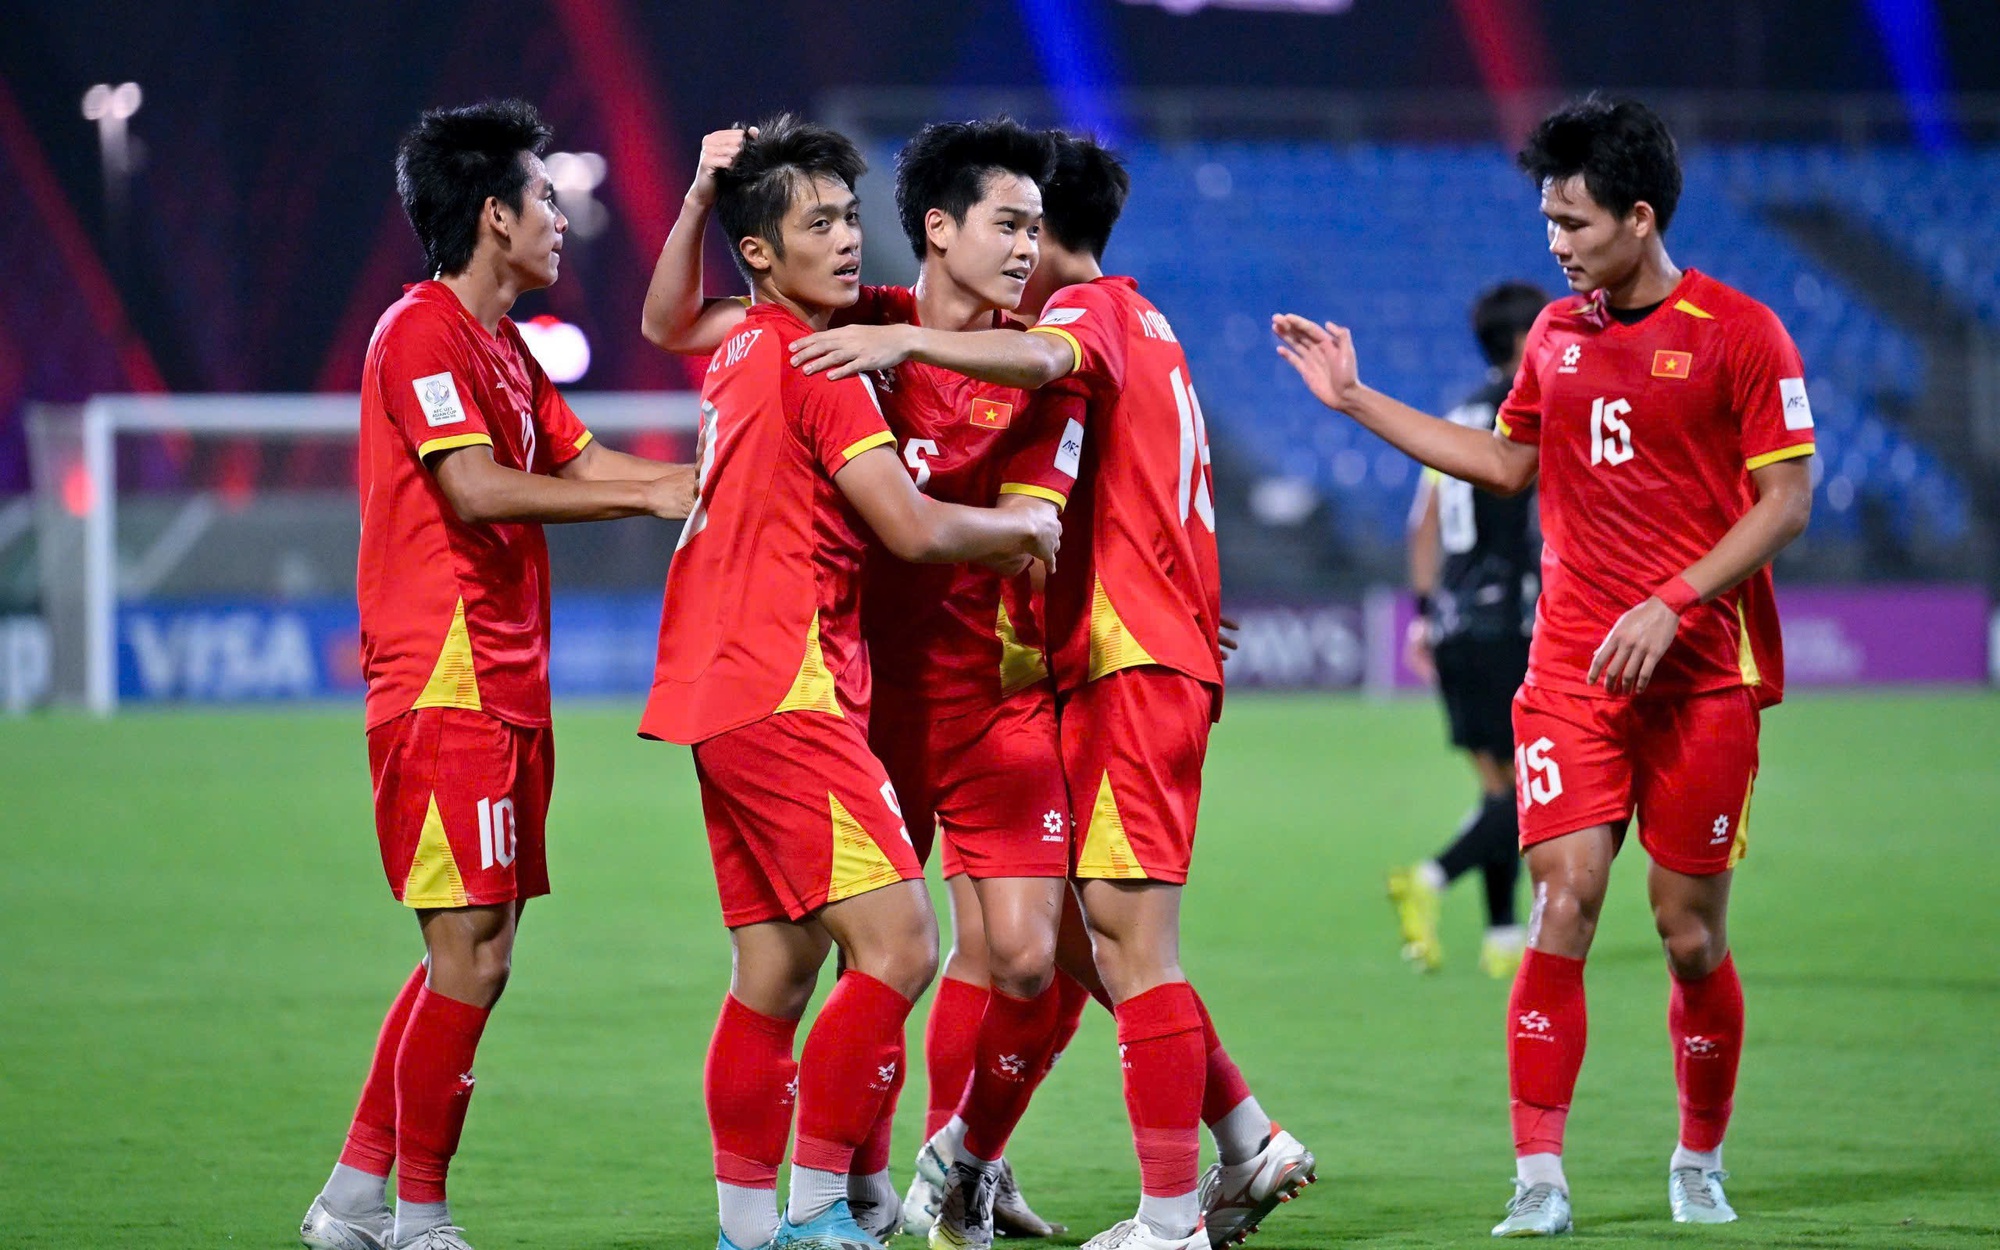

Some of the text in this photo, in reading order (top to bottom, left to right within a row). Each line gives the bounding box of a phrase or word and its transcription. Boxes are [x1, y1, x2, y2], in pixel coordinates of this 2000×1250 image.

[1590, 396, 1634, 467] 15
[1787, 396, 1806, 409] AFC
[1062, 439, 1080, 457] AFC
[128, 612, 314, 692] VISA
[1516, 736, 1563, 811] 15
[477, 796, 517, 871] 10
